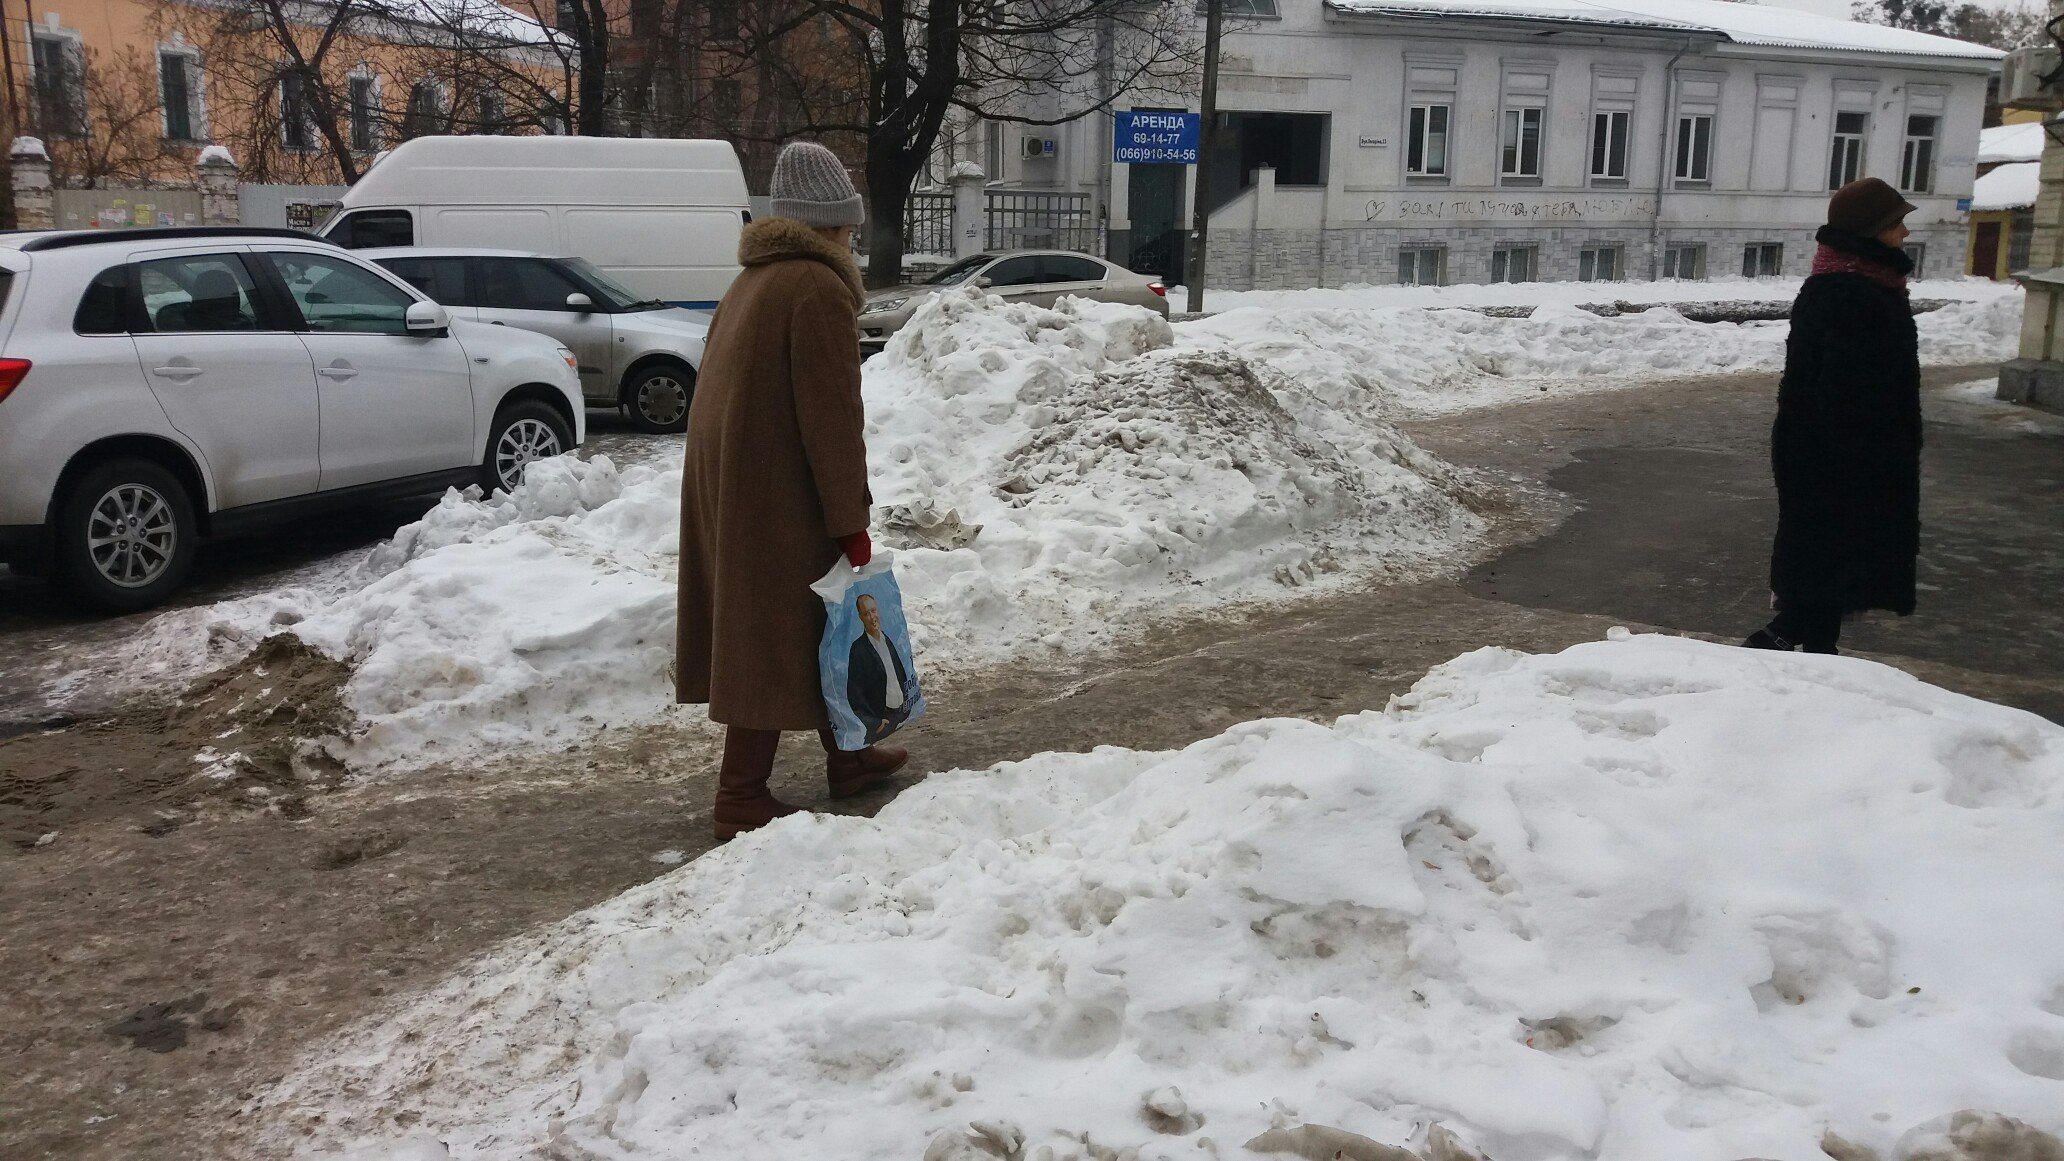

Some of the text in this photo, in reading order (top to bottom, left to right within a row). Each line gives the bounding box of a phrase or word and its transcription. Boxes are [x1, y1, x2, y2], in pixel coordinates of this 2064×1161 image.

[1131, 115, 1185, 130] АРЕНДА
[1133, 132, 1180, 144] 69-14-77
[1116, 148, 1196, 162] (066)910-54-56
